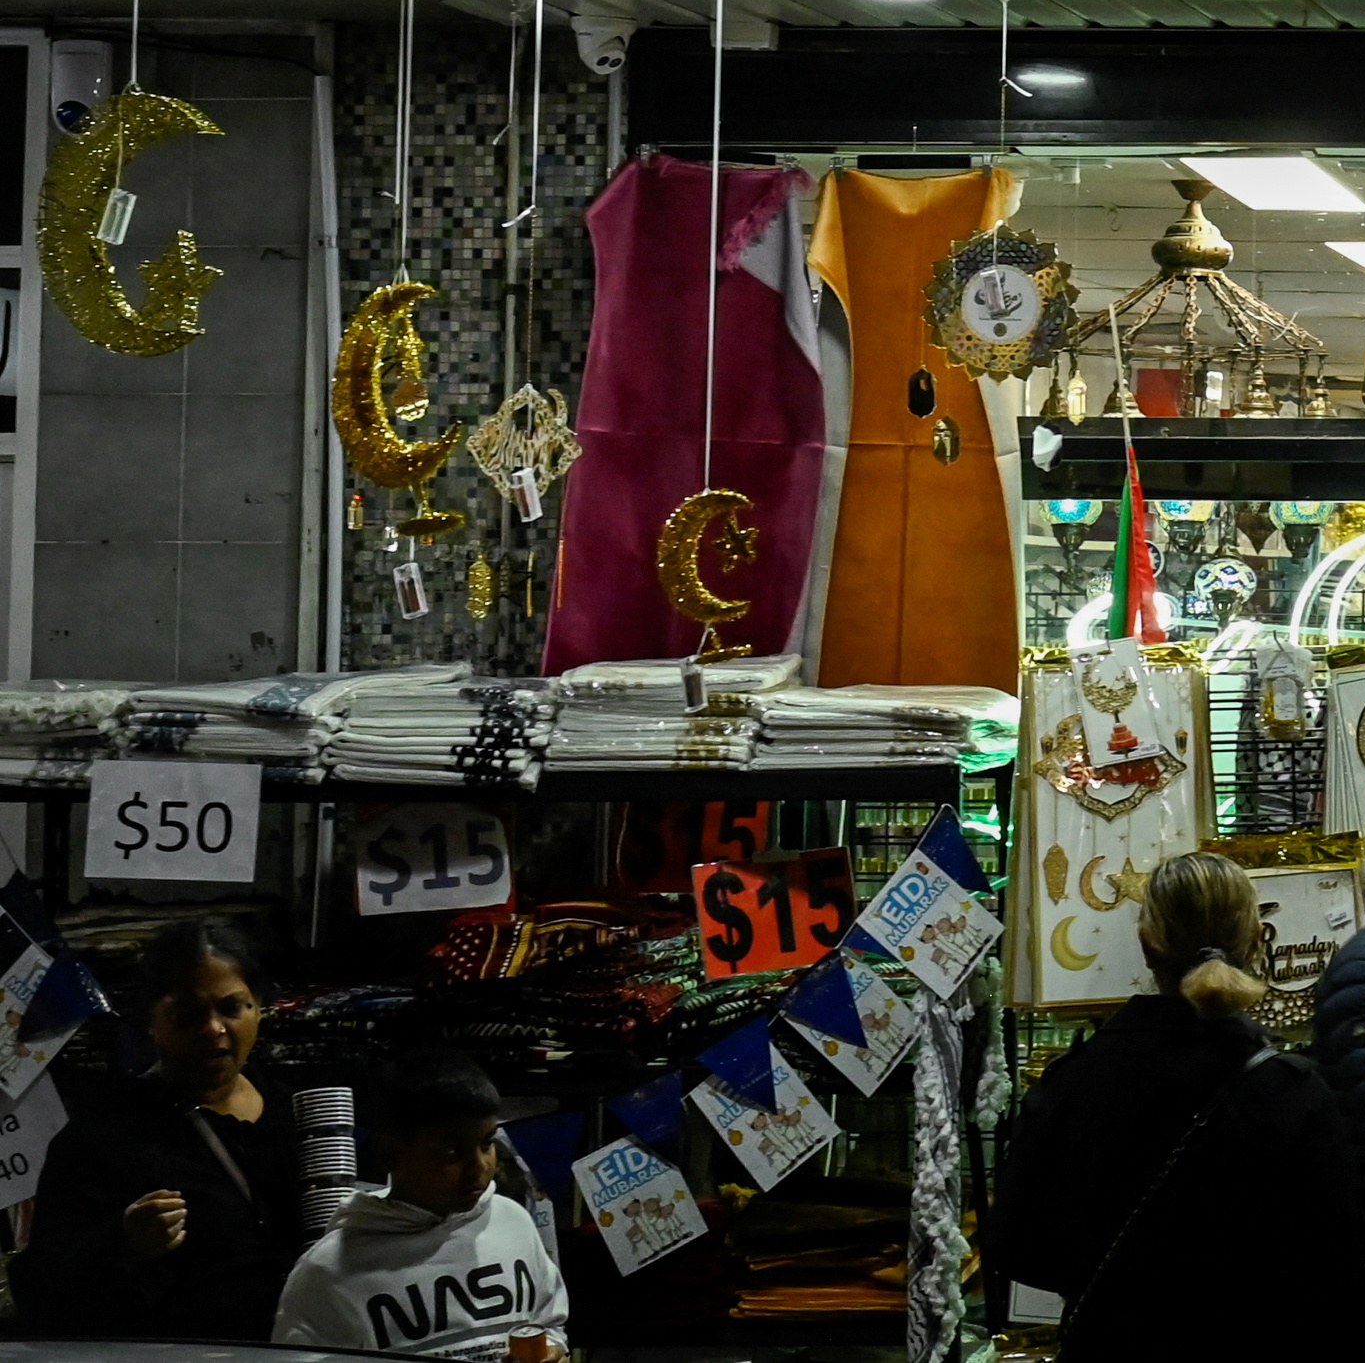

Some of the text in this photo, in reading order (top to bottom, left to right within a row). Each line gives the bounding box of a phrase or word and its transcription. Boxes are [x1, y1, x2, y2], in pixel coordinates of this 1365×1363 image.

[114, 791, 233, 859] $50
[367, 819, 506, 906] $15
[703, 858, 853, 974] $15
[879, 873, 929, 928] EID
[885, 876, 950, 947] MUBARAK
[593, 1147, 649, 1189] EID
[366, 1258, 536, 1350] NASA
